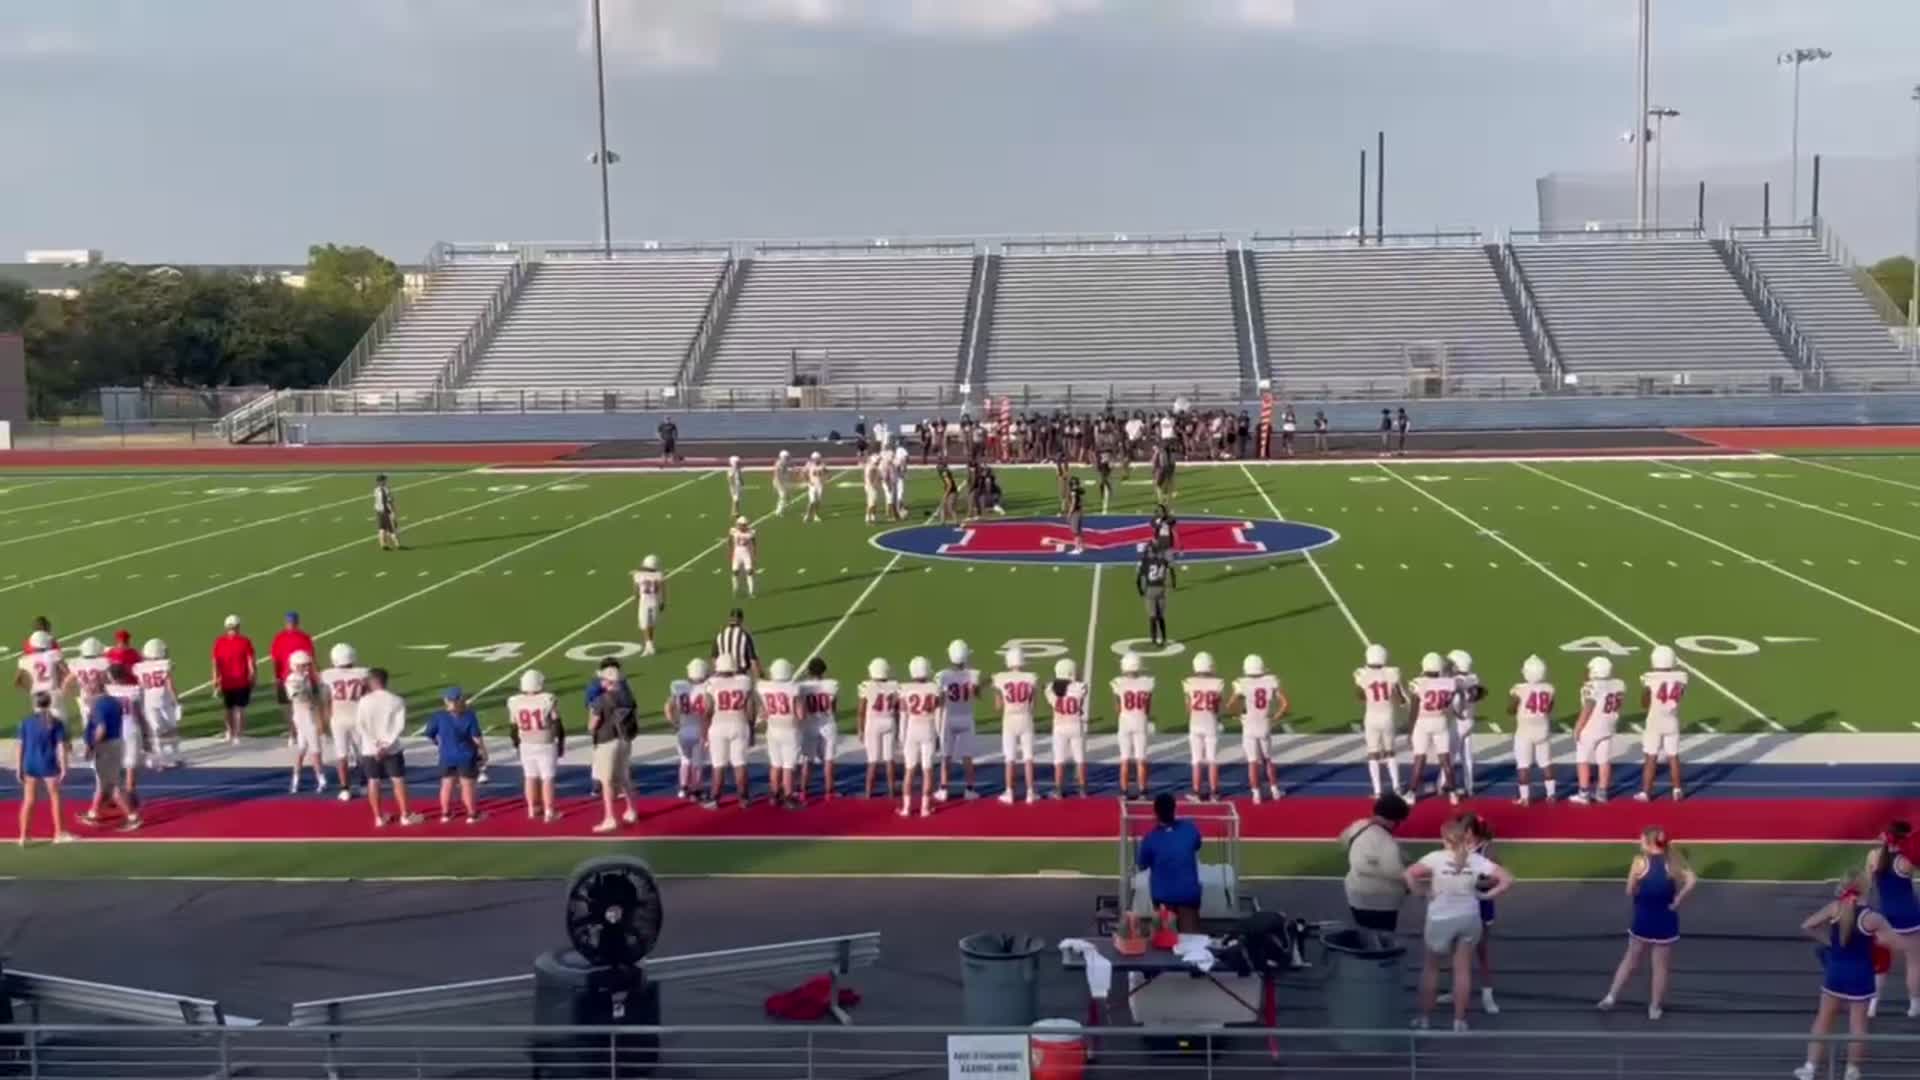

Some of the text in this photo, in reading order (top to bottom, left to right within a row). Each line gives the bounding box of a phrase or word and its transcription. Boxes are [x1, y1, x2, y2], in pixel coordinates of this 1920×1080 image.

[937, 521, 1267, 554] M
[34, 663, 48, 682] 2
[333, 678, 362, 701] 37
[948, 682, 970, 702] 31
[1004, 681, 1030, 703] 30
[1254, 687, 1267, 710] 8
[1369, 681, 1389, 702] 11
[1656, 682, 1682, 704] 44
[717, 690, 744, 711] 92
[873, 693, 893, 712] 41
[909, 693, 935, 714] 24
[1055, 696, 1078, 715] 40
[1525, 690, 1551, 714] 48
[519, 709, 544, 731] 91
